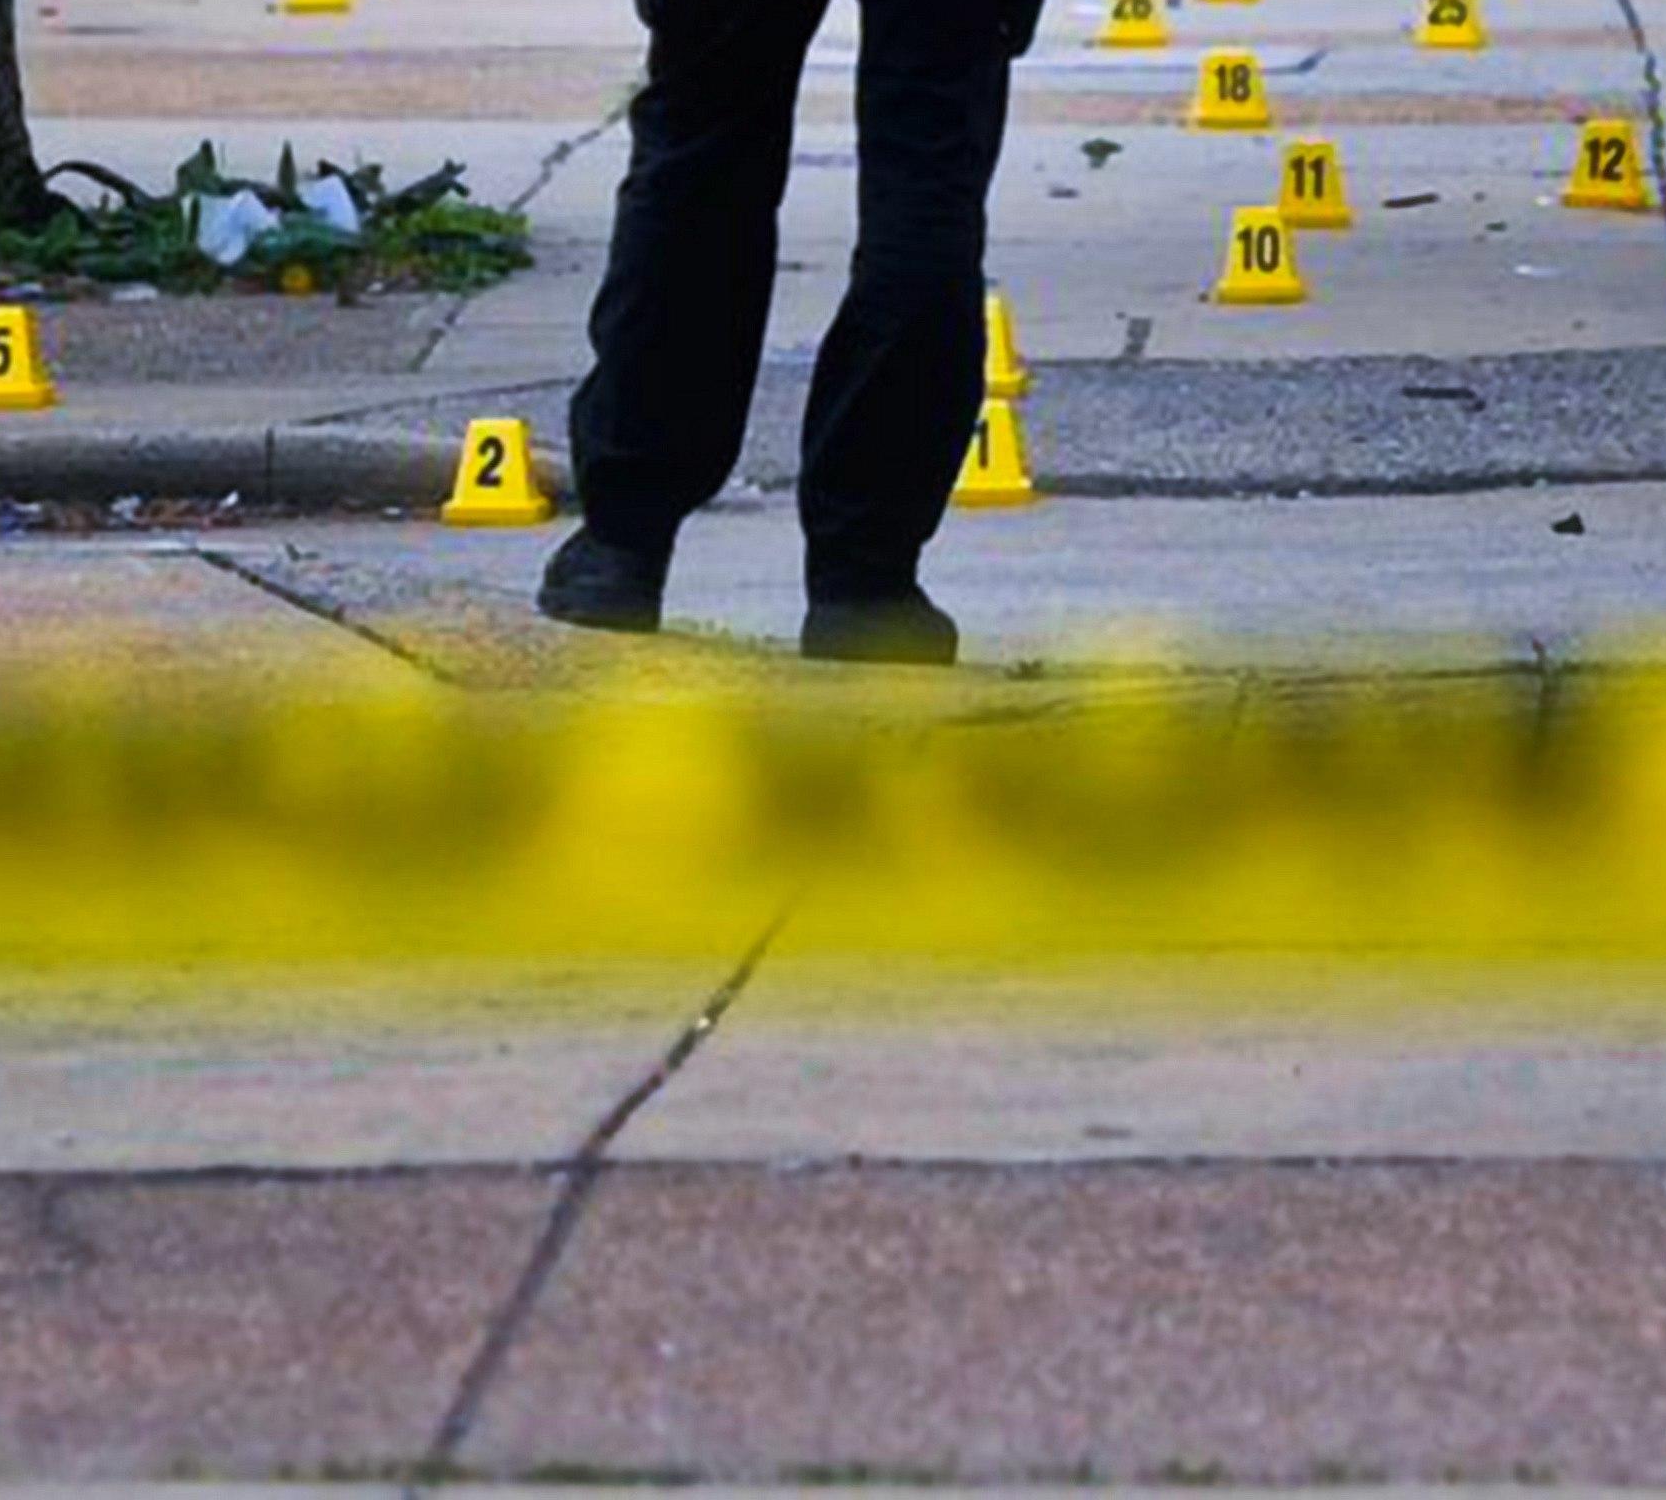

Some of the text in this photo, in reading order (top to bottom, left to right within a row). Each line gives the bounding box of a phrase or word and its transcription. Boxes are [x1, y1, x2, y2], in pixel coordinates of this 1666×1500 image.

[1215, 64, 1252, 103] 18
[1290, 155, 1325, 200] 11
[1584, 137, 1626, 182] 12
[1237, 225, 1280, 273] 10
[476, 436, 505, 488] 2
[975, 418, 989, 470] 1
